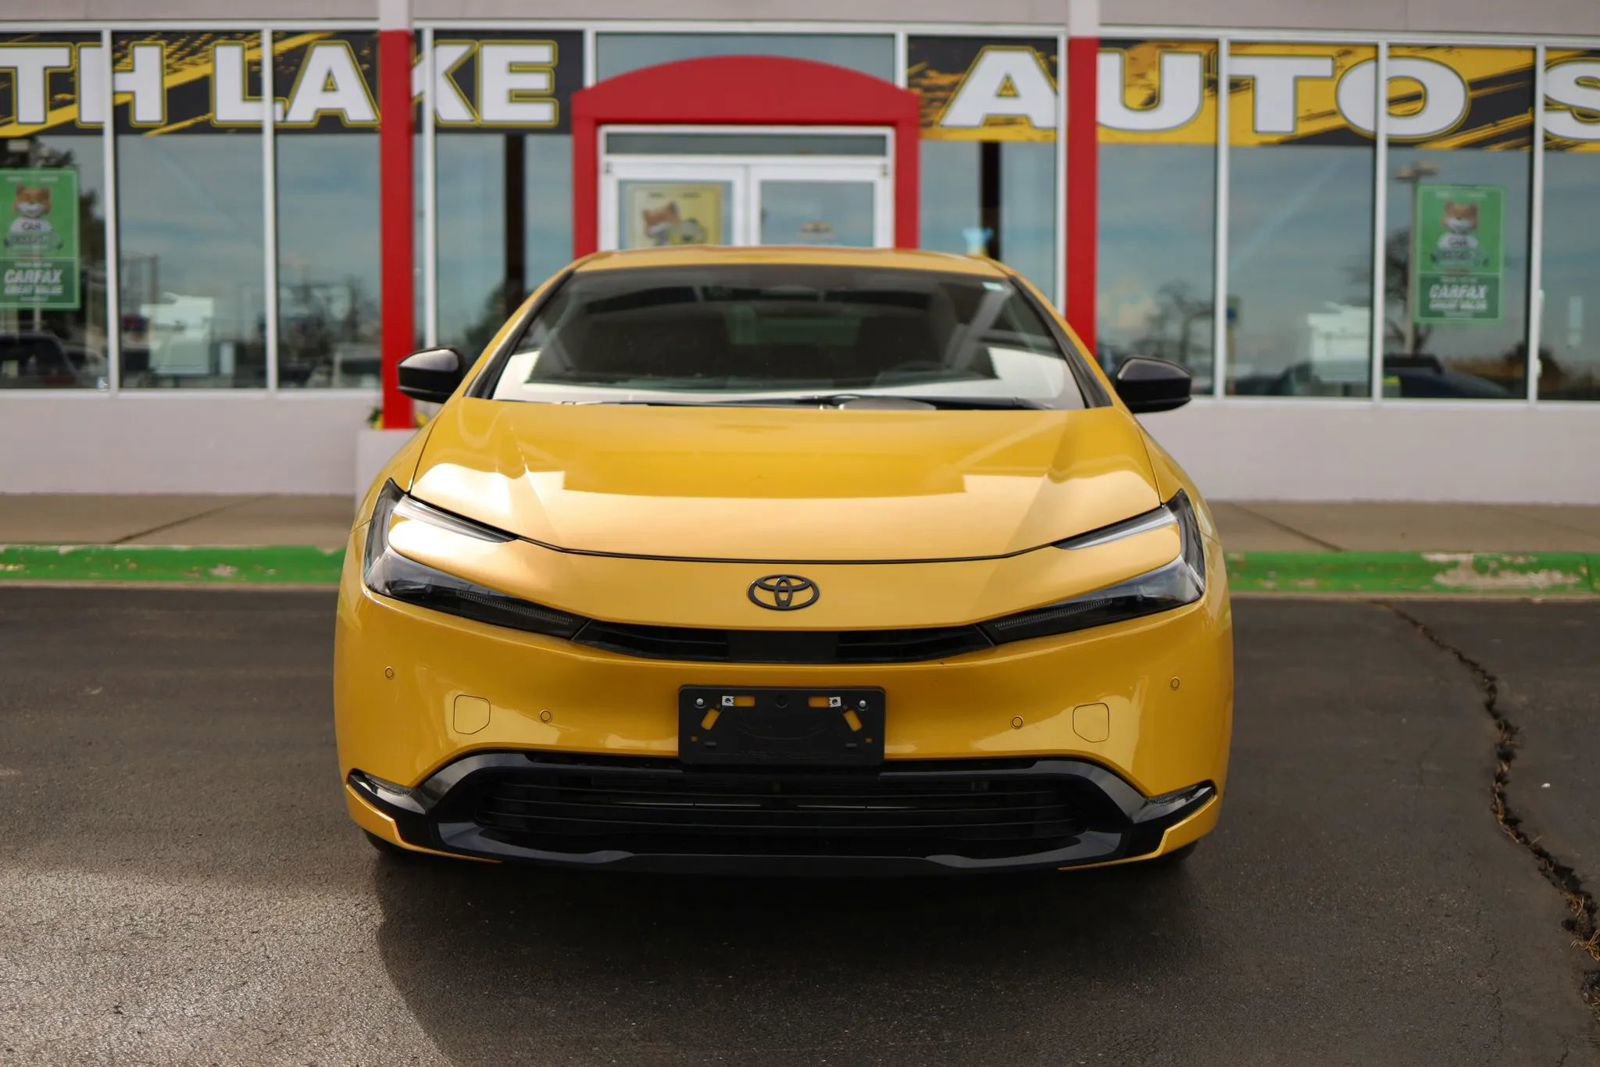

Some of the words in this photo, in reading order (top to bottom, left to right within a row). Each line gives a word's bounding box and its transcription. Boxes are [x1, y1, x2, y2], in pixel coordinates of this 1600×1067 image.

[0, 43, 167, 127] TH
[211, 40, 559, 128] LAKE
[937, 46, 1470, 142] AUTO
[4, 269, 63, 284] CARFAX
[1429, 284, 1488, 299] CARFAX
